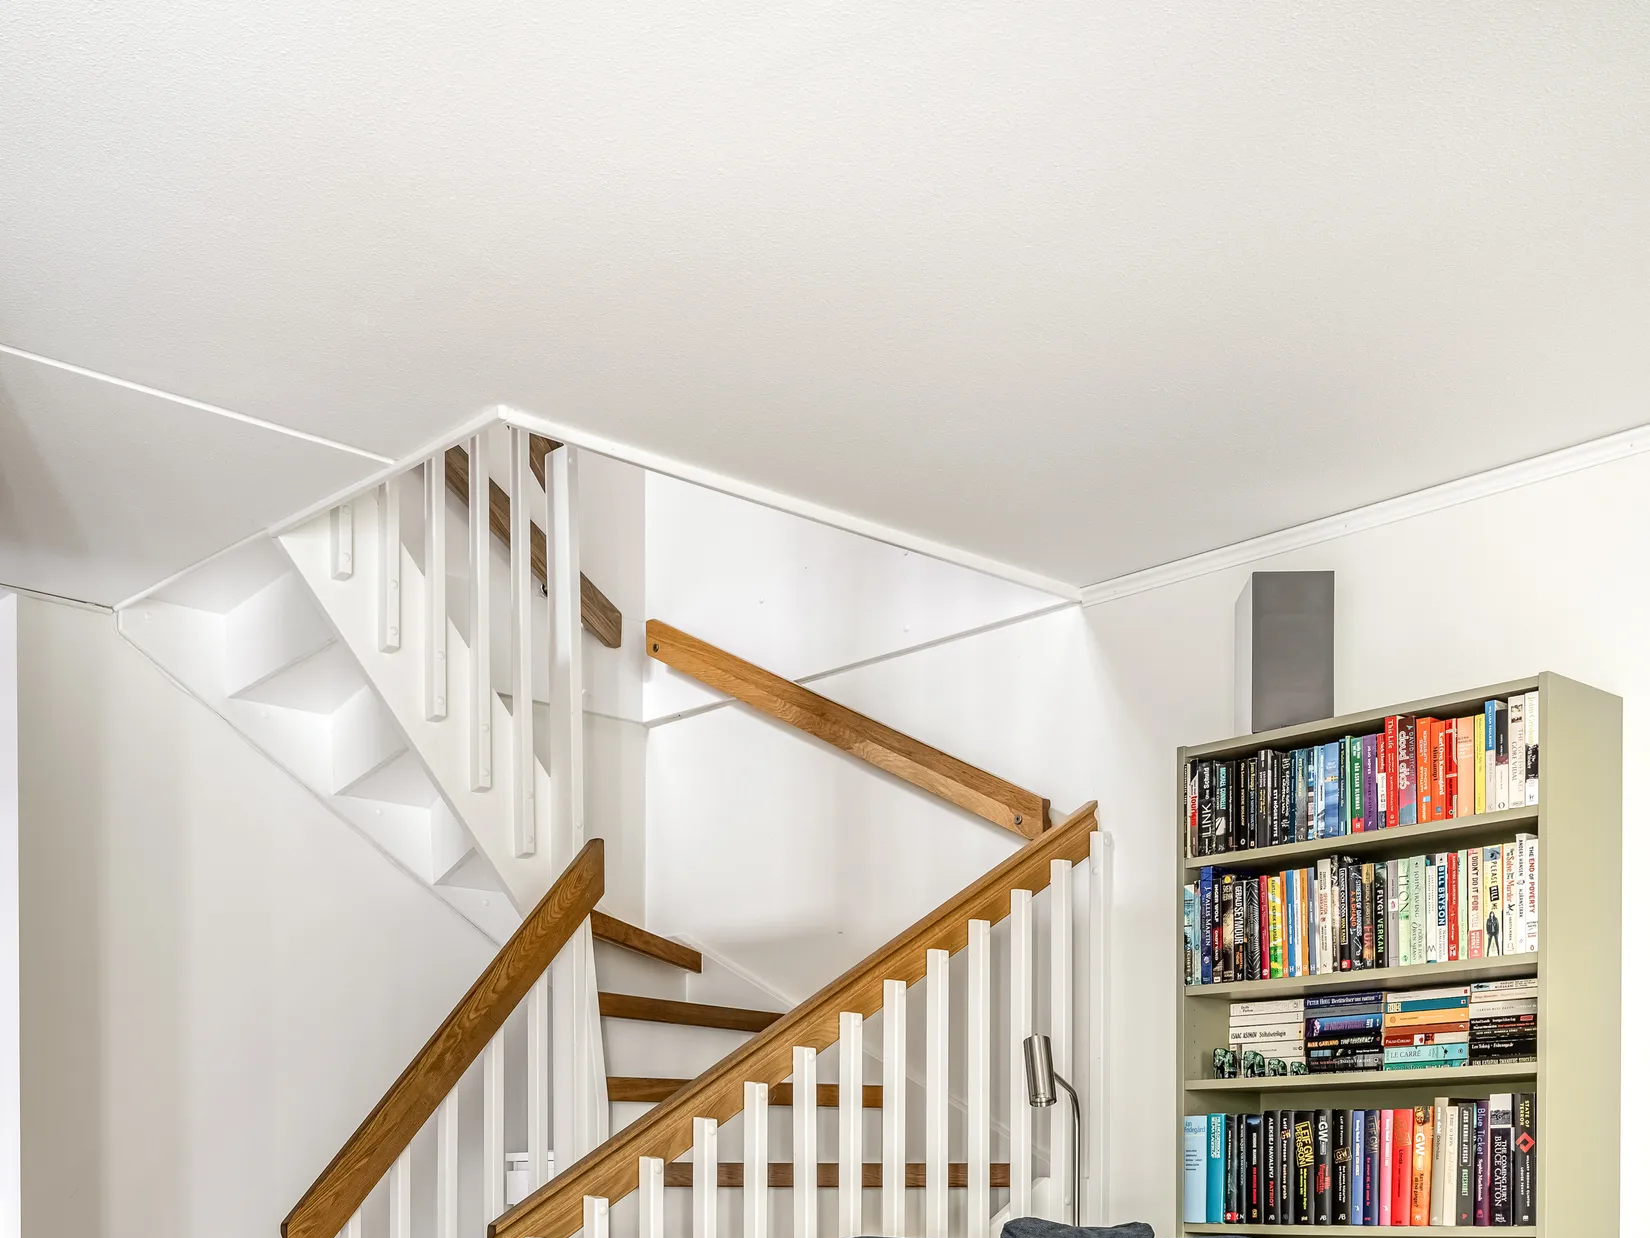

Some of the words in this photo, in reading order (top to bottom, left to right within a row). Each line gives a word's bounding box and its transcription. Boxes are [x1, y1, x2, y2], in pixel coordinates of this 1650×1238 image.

[1190, 796, 1198, 826] tourism
[1202, 803, 1212, 835] LINK
[1471, 856, 1479, 876] DIDN'T
[1505, 856, 1515, 872] Solve
[1438, 866, 1446, 887] BILL
[1472, 877, 1479, 886] DO
[1234, 886, 1242, 906] GERALD
[1376, 890, 1384, 915] FLYGT
[1490, 886, 1499, 901] KILL
[1506, 880, 1515, 903] Murder
[1204, 892, 1212, 917] WALLIS
[1437, 888, 1446, 925] BRYSON
[1204, 918, 1212, 946] MARTIN
[1234, 907, 1244, 944] SEYMOUR
[1376, 918, 1384, 953] VERKAN
[1390, 1051, 1398, 1059] LE
[1399, 1049, 1421, 1059] CARRÉ
[1477, 1108, 1486, 1127] Blue
[1301, 1124, 1311, 1144] LEIF
[1319, 1121, 1329, 1142] GW
[1477, 1130, 1486, 1155] Ticket
[1295, 1126, 1306, 1166] PERSSON
[1303, 1146, 1314, 1162] GW
[1416, 1133, 1425, 1155] GW
[1494, 1136, 1502, 1166] BRUCE
[1476, 1158, 1484, 1174] Sophie
[1494, 1168, 1502, 1207] CATTON
